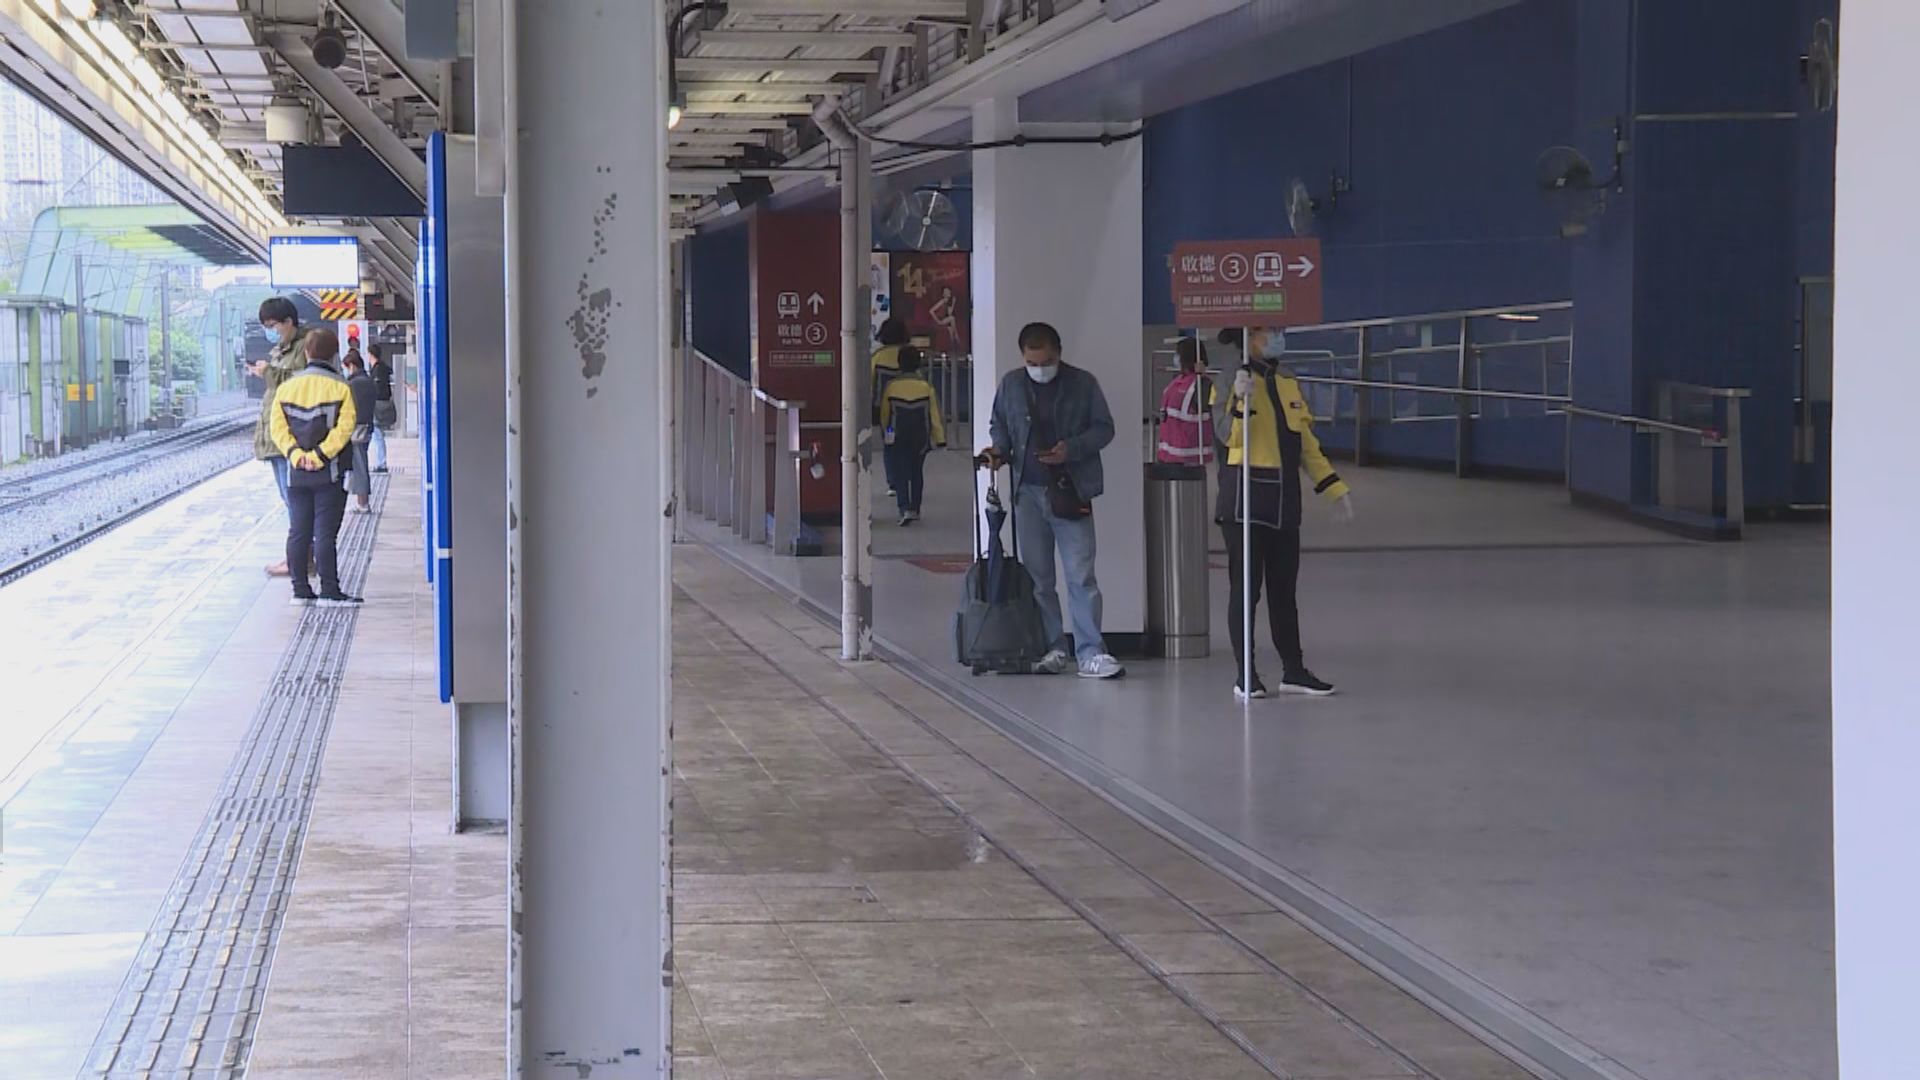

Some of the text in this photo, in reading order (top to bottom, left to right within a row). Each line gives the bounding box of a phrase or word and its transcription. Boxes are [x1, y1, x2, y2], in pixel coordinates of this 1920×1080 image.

[1187, 274, 1215, 283] Kai Tak
[1089, 661, 1100, 673] N
